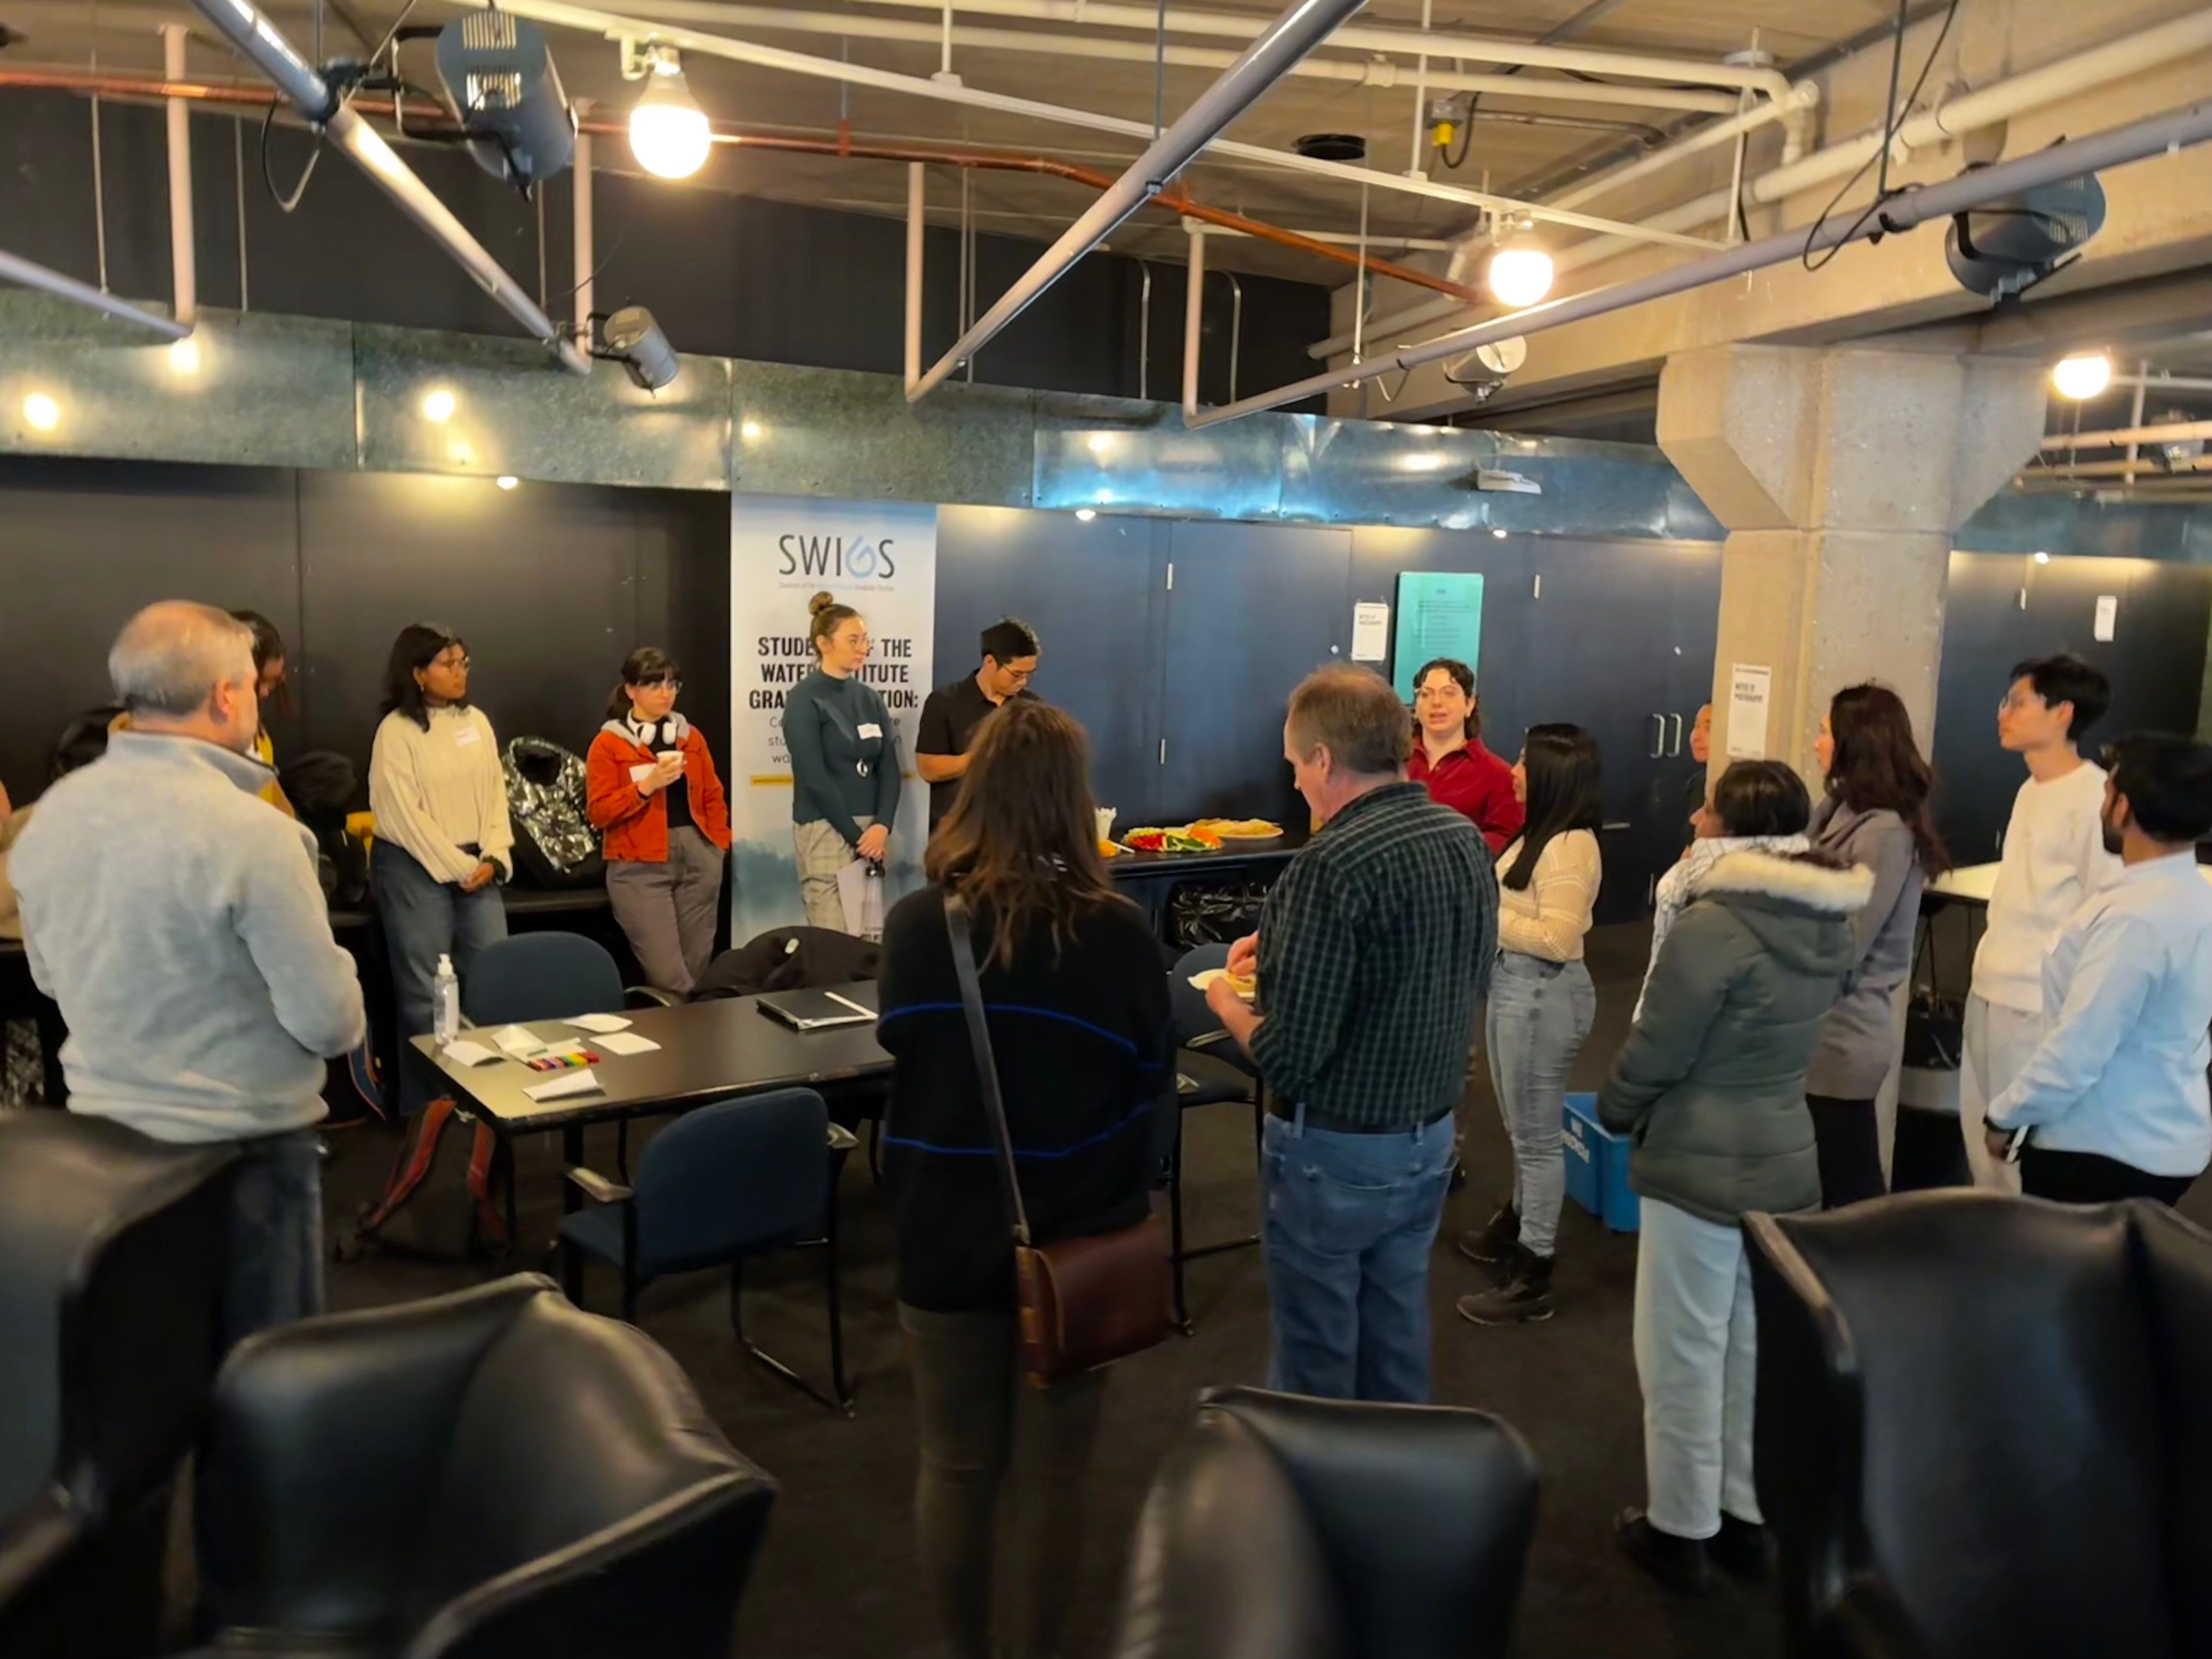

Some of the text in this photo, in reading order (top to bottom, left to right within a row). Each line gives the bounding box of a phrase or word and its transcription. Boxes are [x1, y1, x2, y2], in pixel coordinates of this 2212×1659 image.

[778, 534, 895, 579] SWIGS
[758, 636, 814, 656] STUDE
[881, 639, 912, 657] THE
[855, 664, 909, 683] ITUTE
[877, 689, 919, 708] TION:
